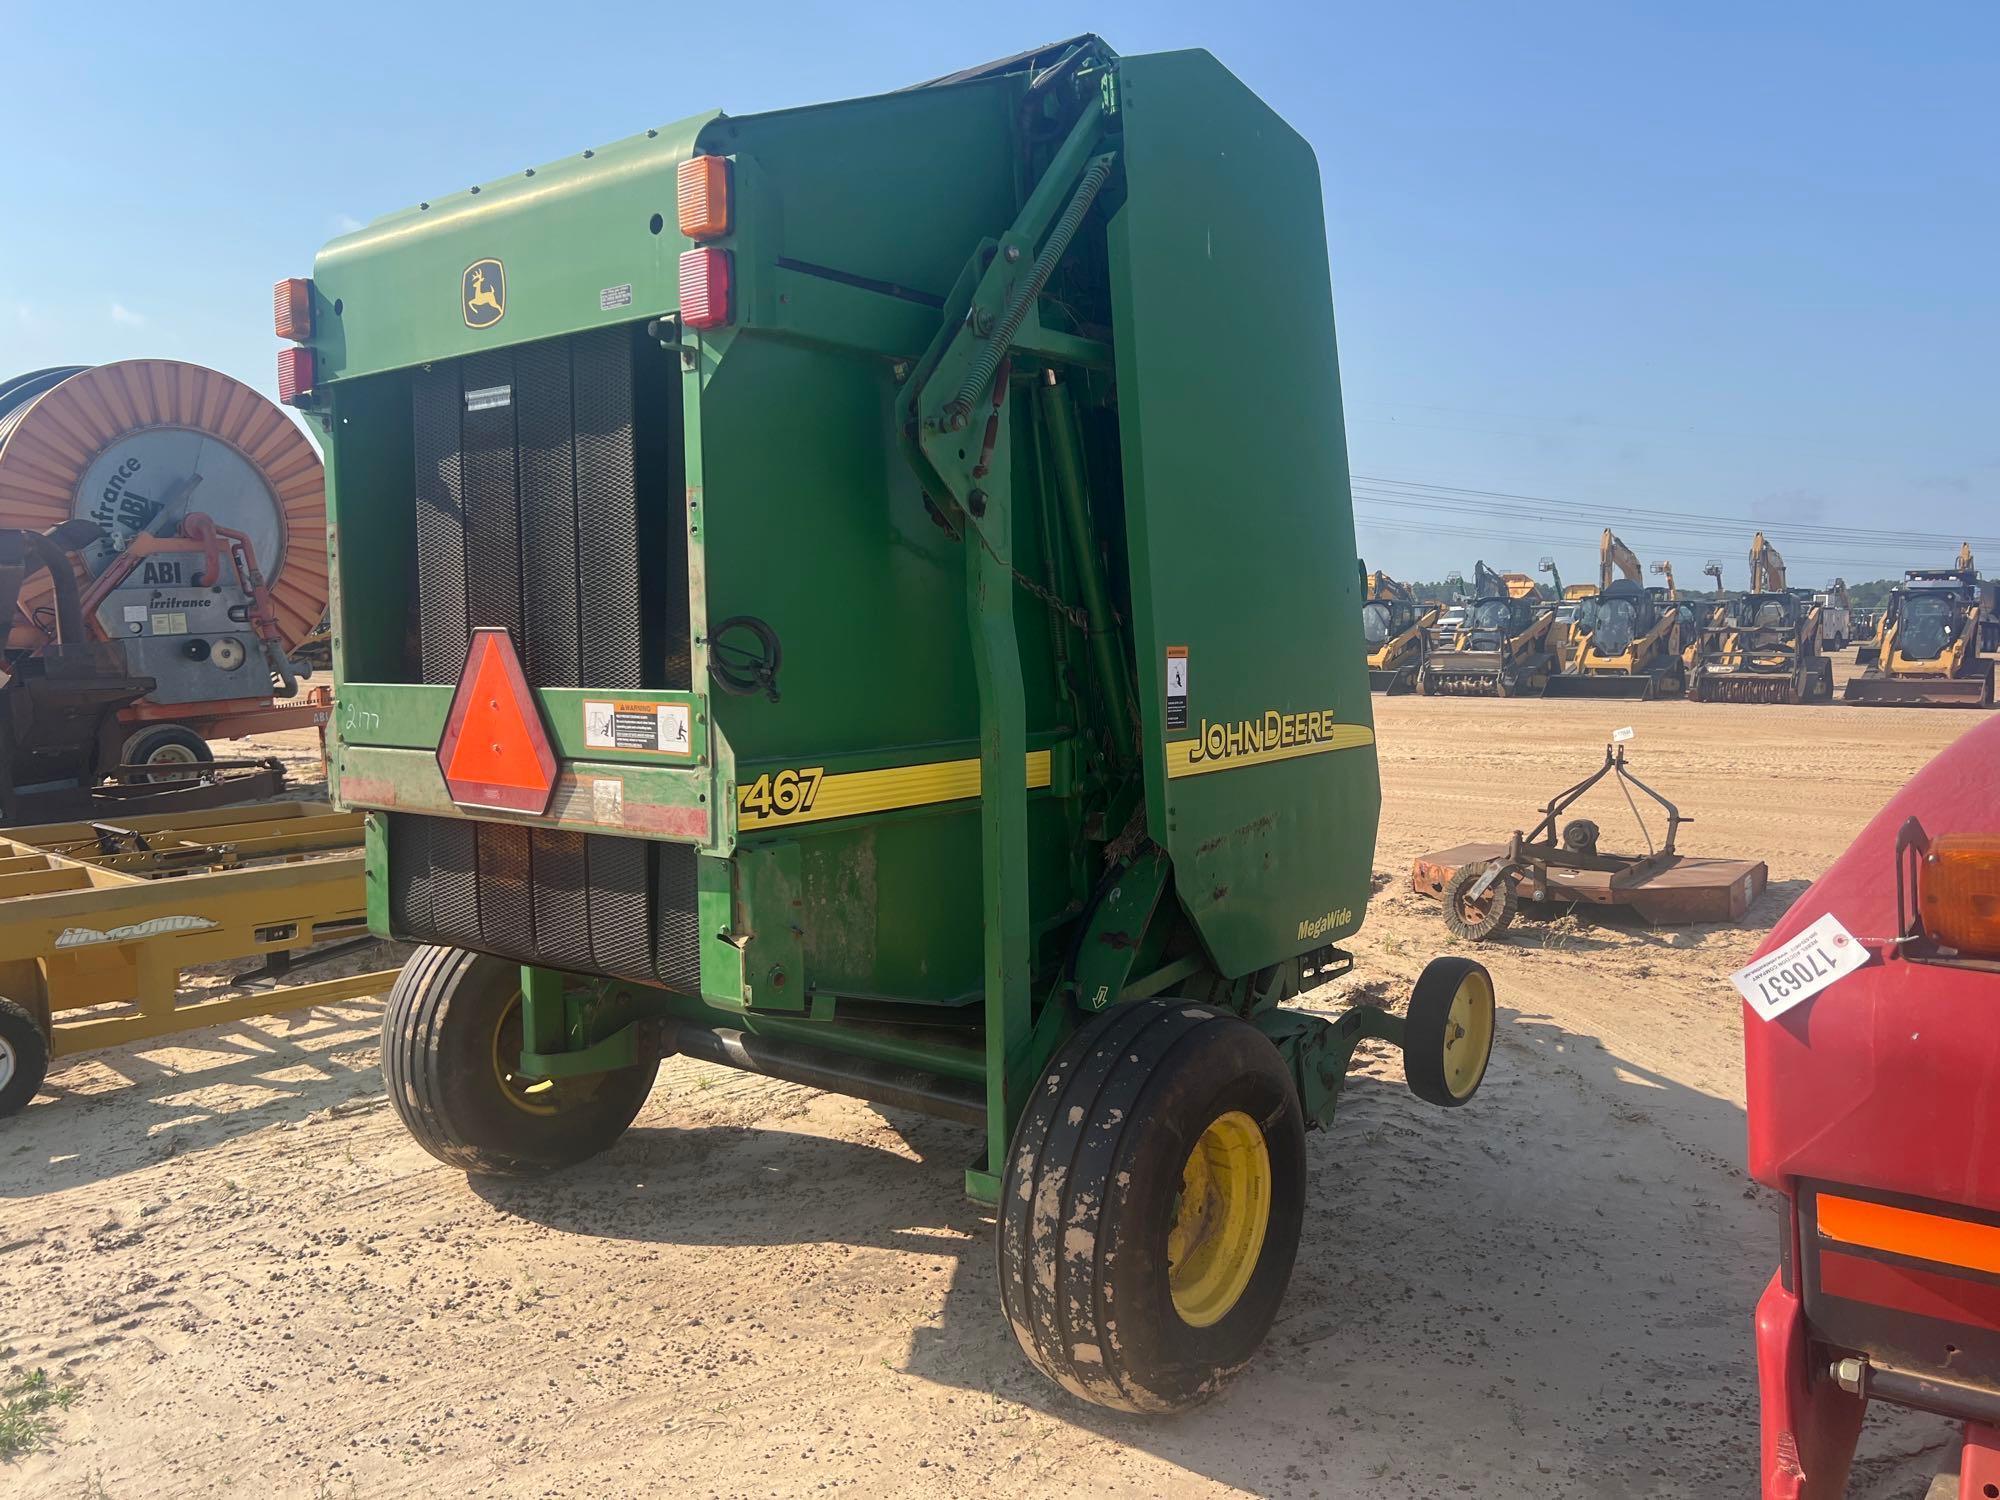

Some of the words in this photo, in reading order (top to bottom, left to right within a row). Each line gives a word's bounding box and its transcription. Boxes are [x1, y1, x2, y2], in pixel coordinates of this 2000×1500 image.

[117, 490, 150, 532] ABI
[143, 561, 182, 585] ABI
[149, 597, 212, 609] irrifrance
[345, 703, 380, 730] 2177
[740, 766, 824, 819] 467
[1297, 907, 1352, 941] MegaWide
[1752, 964, 1779, 981] COMPANY
[1759, 948, 1838, 1006] 170637
